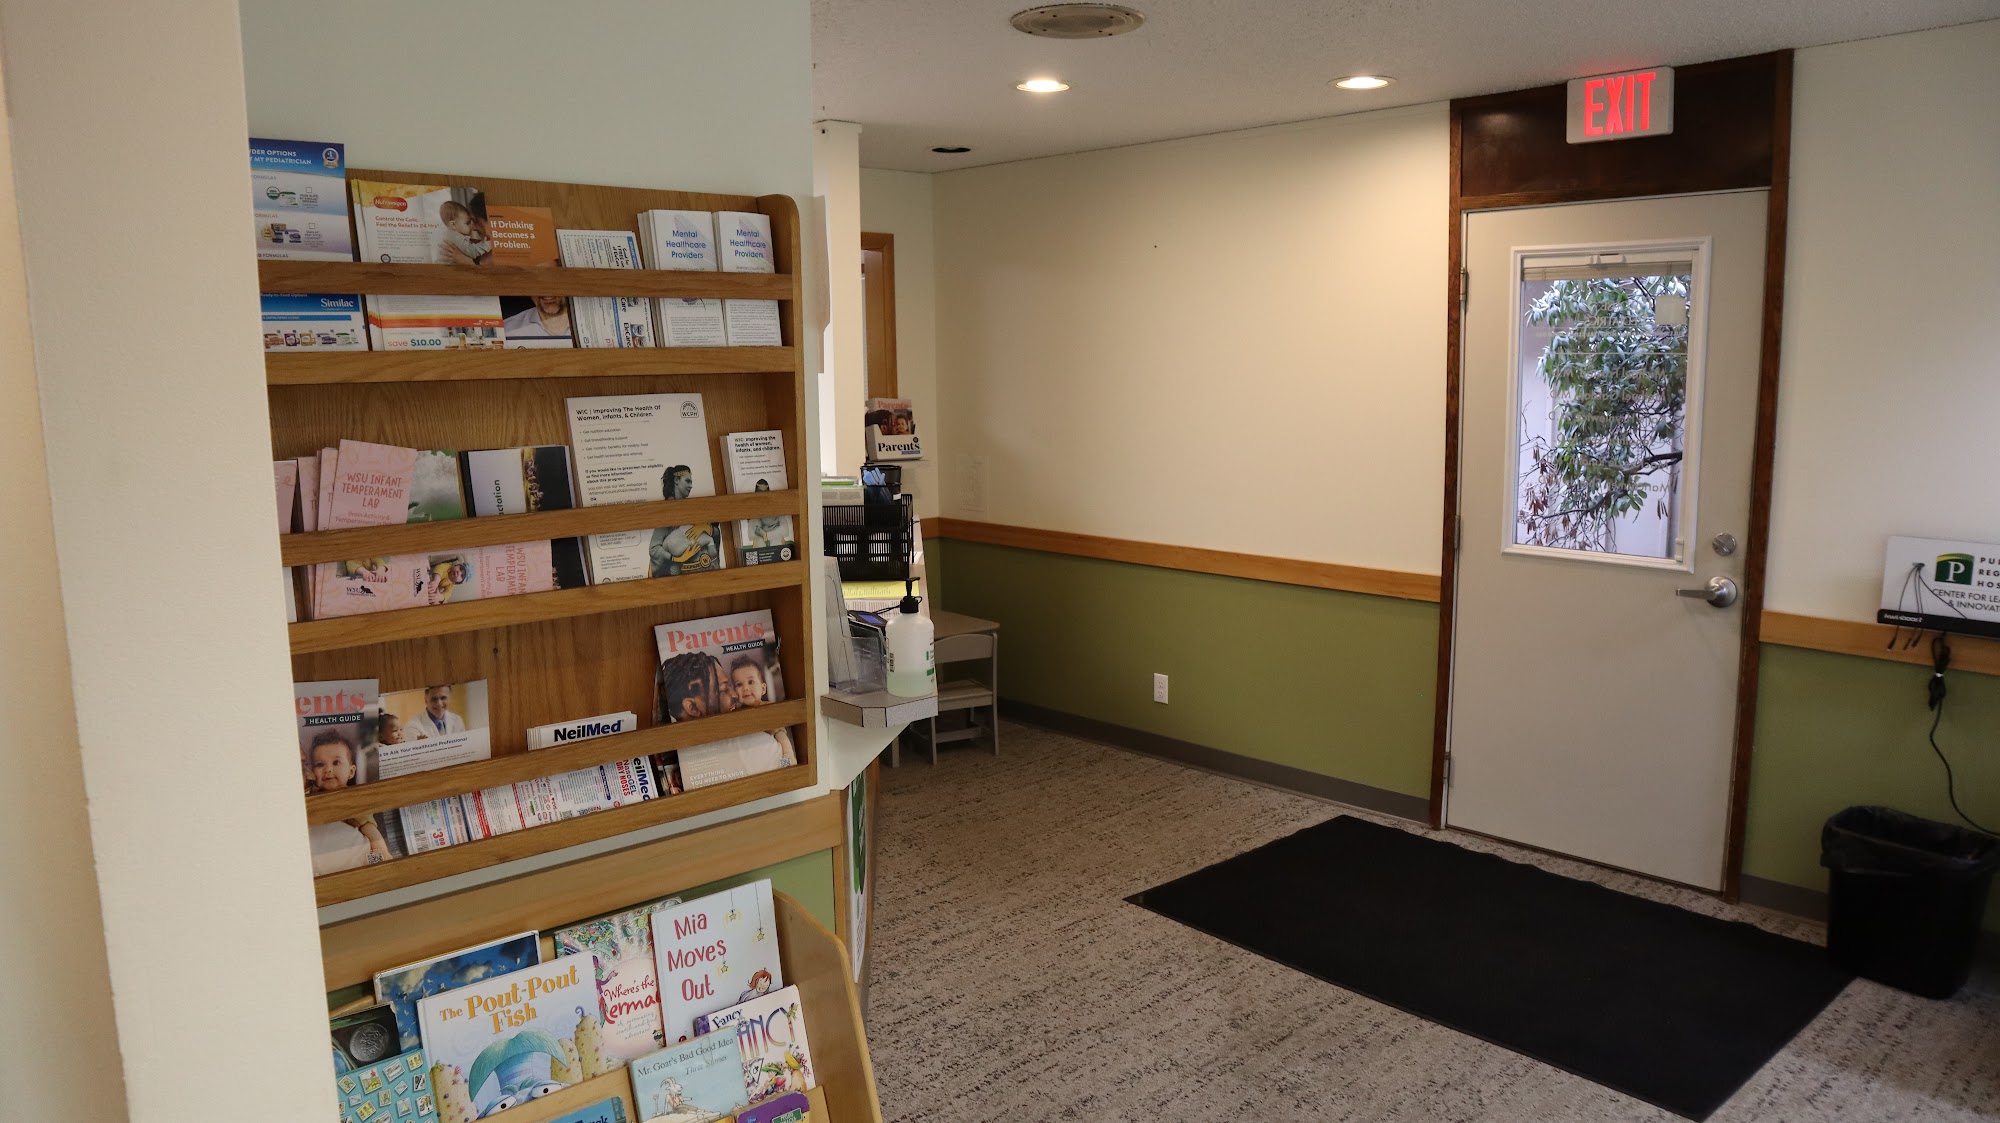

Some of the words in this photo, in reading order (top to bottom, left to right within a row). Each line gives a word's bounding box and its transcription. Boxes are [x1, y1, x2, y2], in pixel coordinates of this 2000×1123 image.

[1584, 72, 1656, 137] EXIT
[265, 157, 312, 165] PEDIATRICIAN
[267, 150, 297, 158] OPTIONS
[374, 198, 407, 208] Nutramigen
[375, 215, 395, 223] Control
[490, 220, 498, 229] If
[498, 220, 534, 231] Drinking
[492, 231, 529, 240] Becomes
[529, 232, 536, 240] a
[672, 230, 698, 238] Mental
[736, 229, 760, 237] Mental
[493, 240, 531, 250] Problem.
[666, 240, 706, 249] Healthcare
[730, 239, 767, 249] Healthcare
[671, 251, 704, 260] Providers
[734, 250, 764, 259] Providers
[320, 297, 354, 308] Similac
[388, 339, 408, 348] save
[410, 338, 442, 347] $10.00
[592, 406, 622, 416] Improving
[877, 400, 912, 409] Parents
[577, 414, 602, 422] Women,
[602, 412, 624, 420] Infants,
[630, 411, 654, 419] Children.
[877, 442, 920, 452] Parents
[347, 472, 369, 483] WSU
[371, 474, 402, 487] INFANT
[342, 482, 403, 500] TEMPERAMENT
[493, 480, 505, 515] actation
[362, 497, 380, 509] LAB
[516, 547, 526, 567] WSU
[495, 566, 506, 582] LAB
[1945, 560, 1966, 583] P
[517, 568, 528, 595] INFAN
[1932, 588, 1966, 599] CENTER
[1968, 592, 1987, 602] FOR
[1948, 599, 1955, 608] &
[667, 620, 766, 653] Parents
[726, 643, 747, 652] HEALTH
[748, 640, 764, 649] GUIDE
[295, 688, 367, 716] ents
[309, 716, 337, 725] HEALTH
[339, 714, 361, 723] GUIDE
[553, 719, 622, 742] NeilMed
[412, 742, 438, 752] Healthcare
[438, 736, 468, 747] Professional
[616, 761, 625, 775] DRY
[689, 769, 725, 781] EVERYTHING
[728, 770, 744, 779] KNOW
[623, 759, 637, 796] NasoGEL
[633, 757, 651, 802] eilMe
[620, 776, 630, 797] NOSES
[674, 913, 708, 941] Mia
[667, 939, 727, 972] Moves
[440, 1006, 464, 1022] The
[464, 965, 580, 1020] Pout-Pout
[603, 980, 640, 1001] Where's
[641, 974, 655, 990] the
[682, 974, 715, 1002] Out
[492, 1003, 539, 1036] Fish
[712, 1008, 743, 1029] Fancy
[736, 1005, 795, 1061] ANCY
[637, 1065, 654, 1078] Mr.
[653, 1056, 678, 1073] Goat's
[679, 1050, 695, 1064] Bad
[696, 1040, 717, 1057] Good
[717, 1036, 734, 1050] Idea
[685, 1062, 704, 1076] Three
[705, 1054, 728, 1069] Stories
